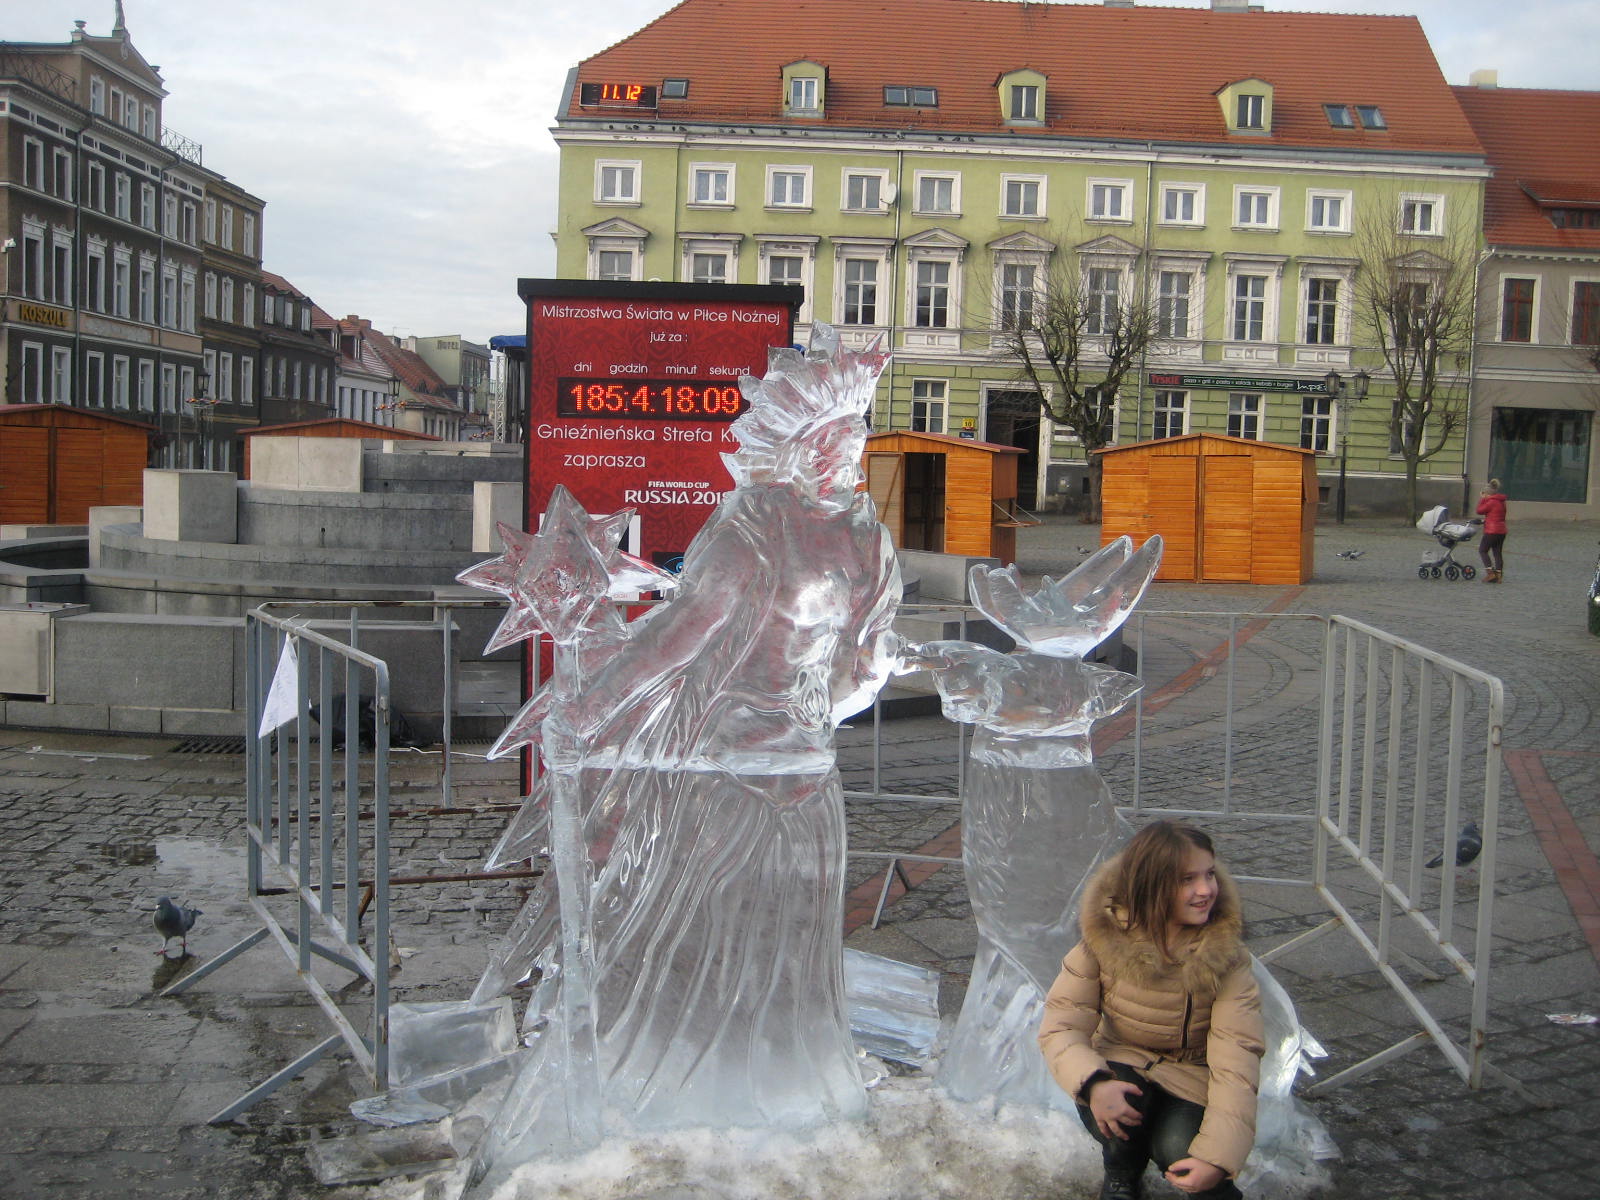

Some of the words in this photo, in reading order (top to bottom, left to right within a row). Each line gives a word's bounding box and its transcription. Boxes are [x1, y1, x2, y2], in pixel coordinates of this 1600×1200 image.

[542, 305, 622, 319] Mistrzostwa
[626, 304, 674, 320] Świata
[677, 311, 690, 321] w
[694, 308, 728, 322] Piłce
[731, 310, 780, 326] Nożnej
[649, 331, 666, 344] już
[668, 334, 682, 342] za
[573, 362, 592, 373] dni
[609, 363, 648, 375] godzin
[665, 364, 698, 375] minut
[709, 365, 750, 377] sekund
[537, 424, 655, 441] Gnieźnieńska
[662, 426, 713, 443] Strefa
[563, 454, 646, 470] zaprasza
[648, 480, 665, 488] FIFA
[665, 481, 694, 489] WORLD
[624, 489, 690, 504] RUSSIA
